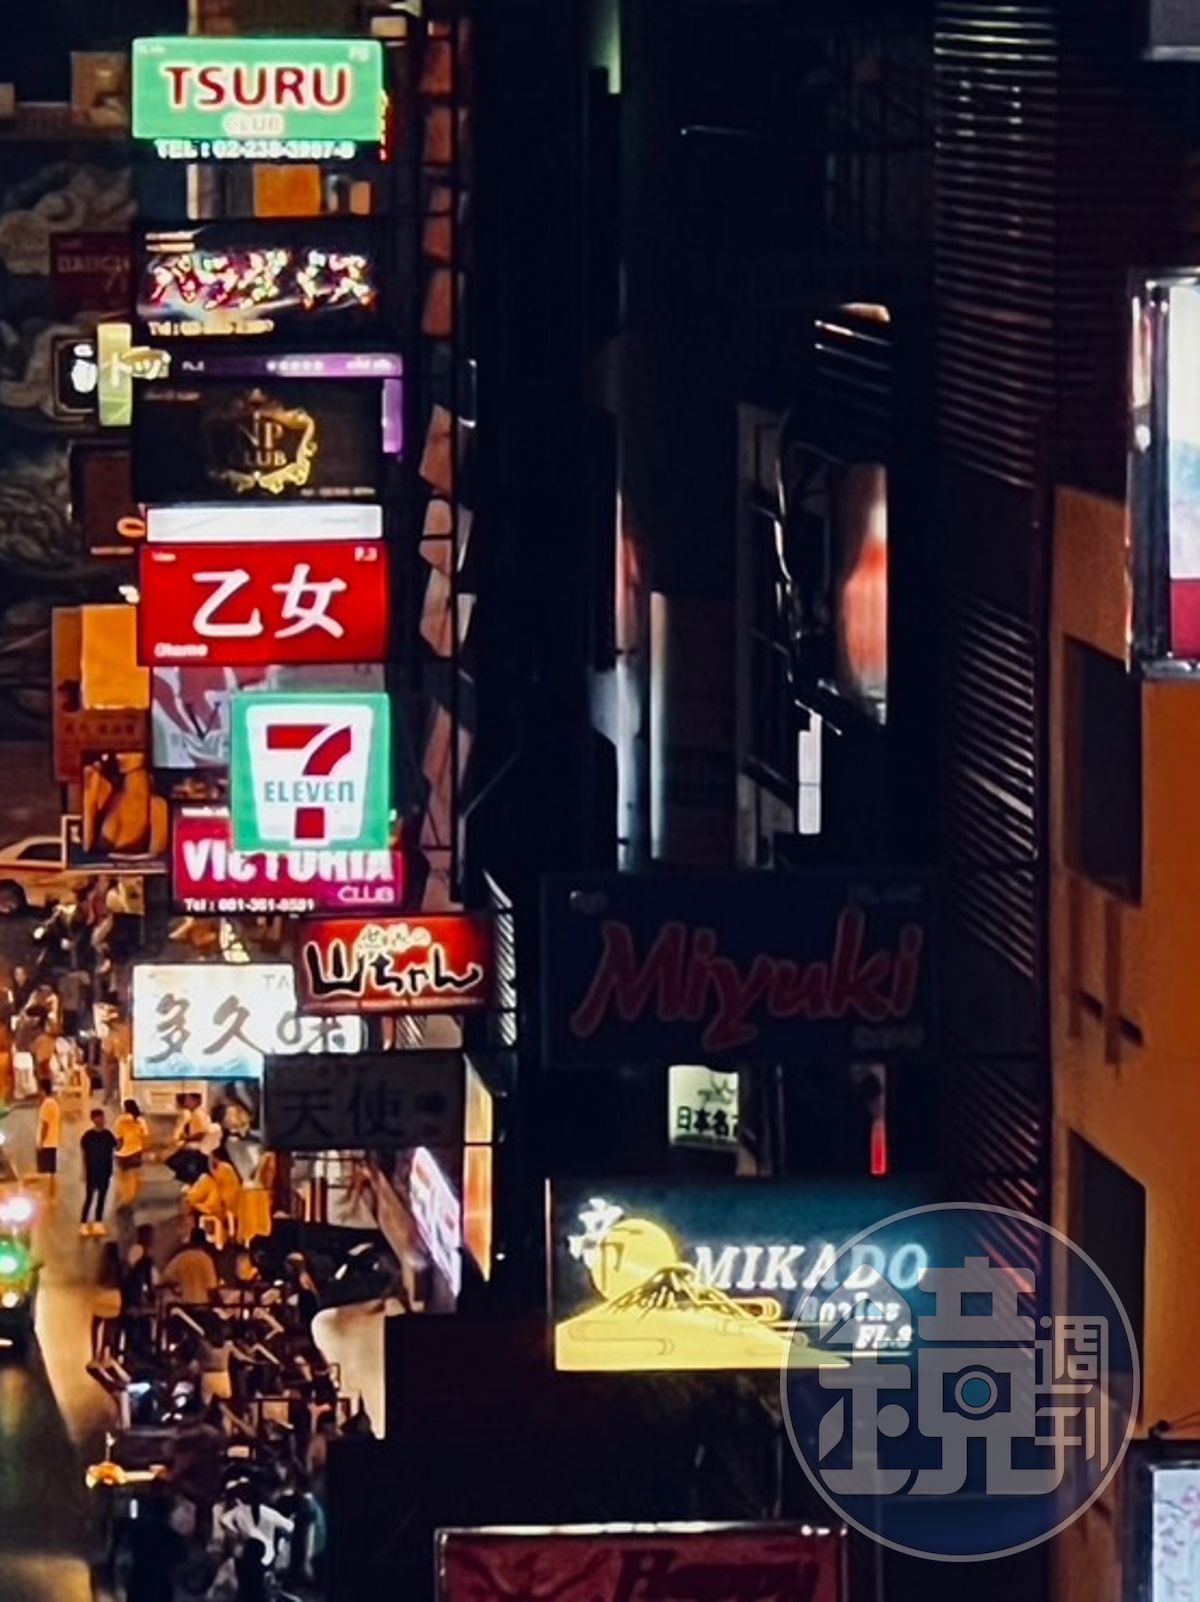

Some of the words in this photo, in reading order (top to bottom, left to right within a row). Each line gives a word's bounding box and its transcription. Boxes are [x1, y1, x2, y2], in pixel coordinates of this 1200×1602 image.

[163, 65, 350, 107] TSURU
[192, 563, 347, 639] 乙女
[337, 886, 395, 903] CLUB
[305, 941, 482, 996] 山ちゃん
[569, 904, 924, 1053] Miyuki
[693, 1243, 930, 1291] MIKADO
